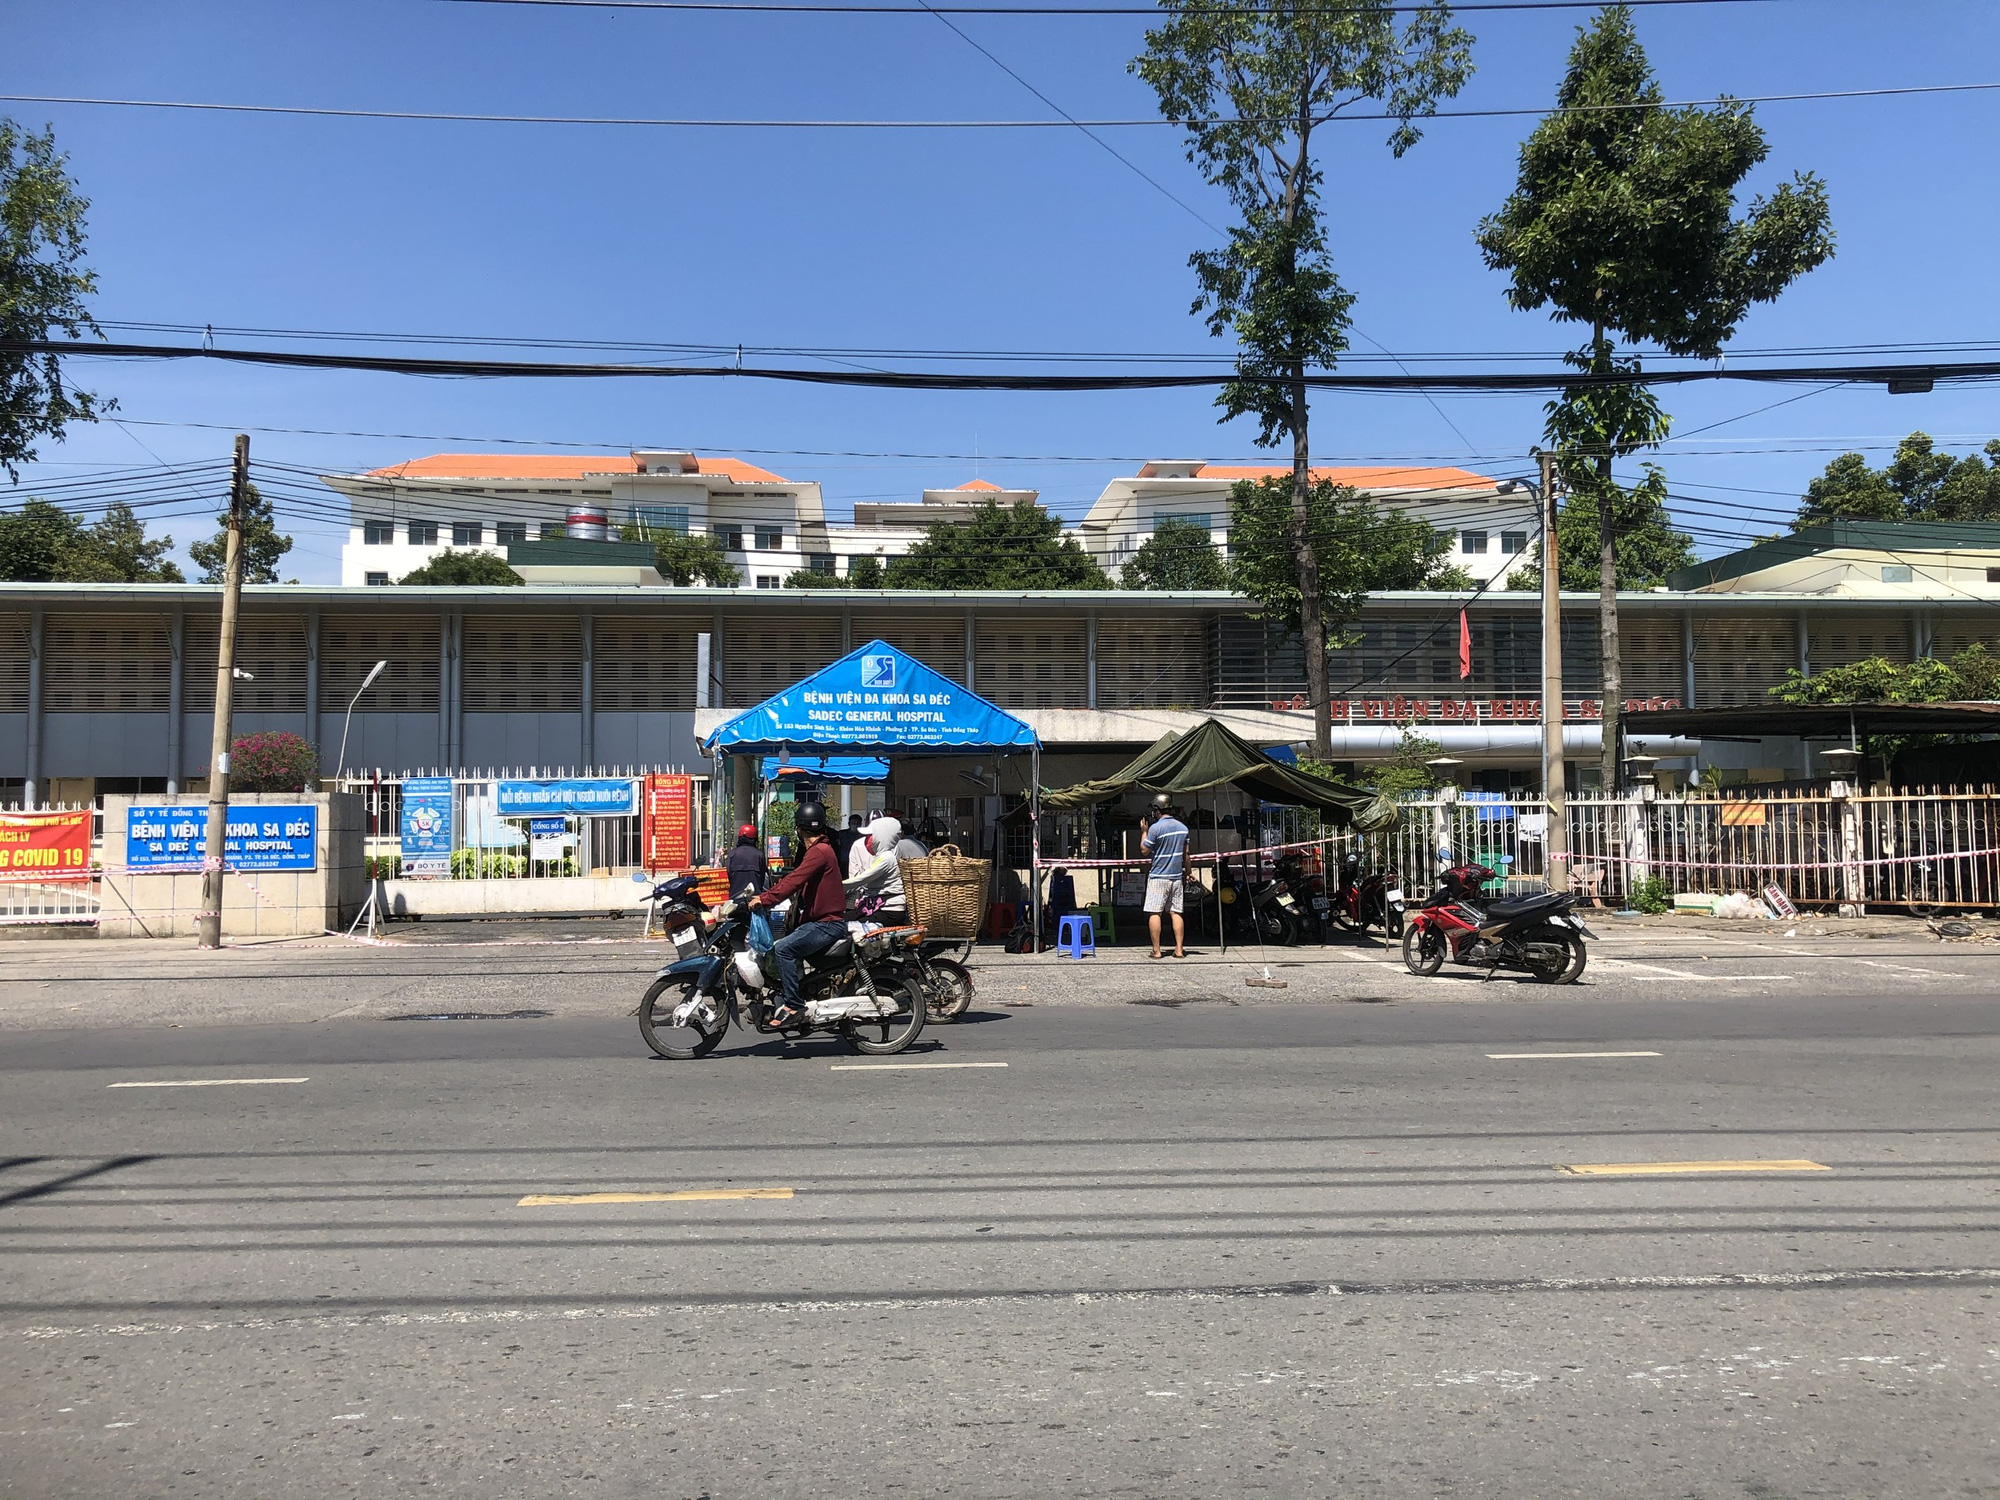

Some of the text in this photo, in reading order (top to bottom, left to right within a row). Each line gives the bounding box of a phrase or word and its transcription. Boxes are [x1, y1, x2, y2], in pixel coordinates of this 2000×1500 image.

[804, 690, 951, 706] BỆNH VIỆN ĐA KHOA SA ĐÉC
[808, 709, 946, 722] SADEC GENERAL HOSPITAL
[1361, 694, 1430, 724] VIỆN
[1440, 699, 1477, 719] ĐA
[1580, 699, 1603, 719] S
[514, 790, 531, 805] BỆNH
[532, 790, 550, 803] NHÂN
[562, 790, 576, 804] MỘT
[577, 789, 595, 803] NGƯỜI
[597, 789, 611, 802] NUÔI
[612, 788, 629, 803] BỆNH
[133, 808, 146, 817] SỞ
[158, 808, 169, 817] TẾ
[172, 808, 193, 817] ĐỒNG
[60, 818, 70, 826] SA
[533, 821, 550, 829] CỔNG
[551, 820, 559, 829] SỐ
[131, 820, 165, 842] BỆNH
[170, 820, 199, 840] VIỆN
[225, 823, 258, 837] KHOA
[263, 823, 280, 837] SA
[285, 817, 310, 837] ĐÉC
[20, 832, 31, 842] LY
[149, 842, 163, 851] SA
[168, 842, 189, 851] DEC
[245, 841, 293, 850] HOSPITAL
[13, 848, 59, 867] COVID
[63, 848, 83, 866] 19
